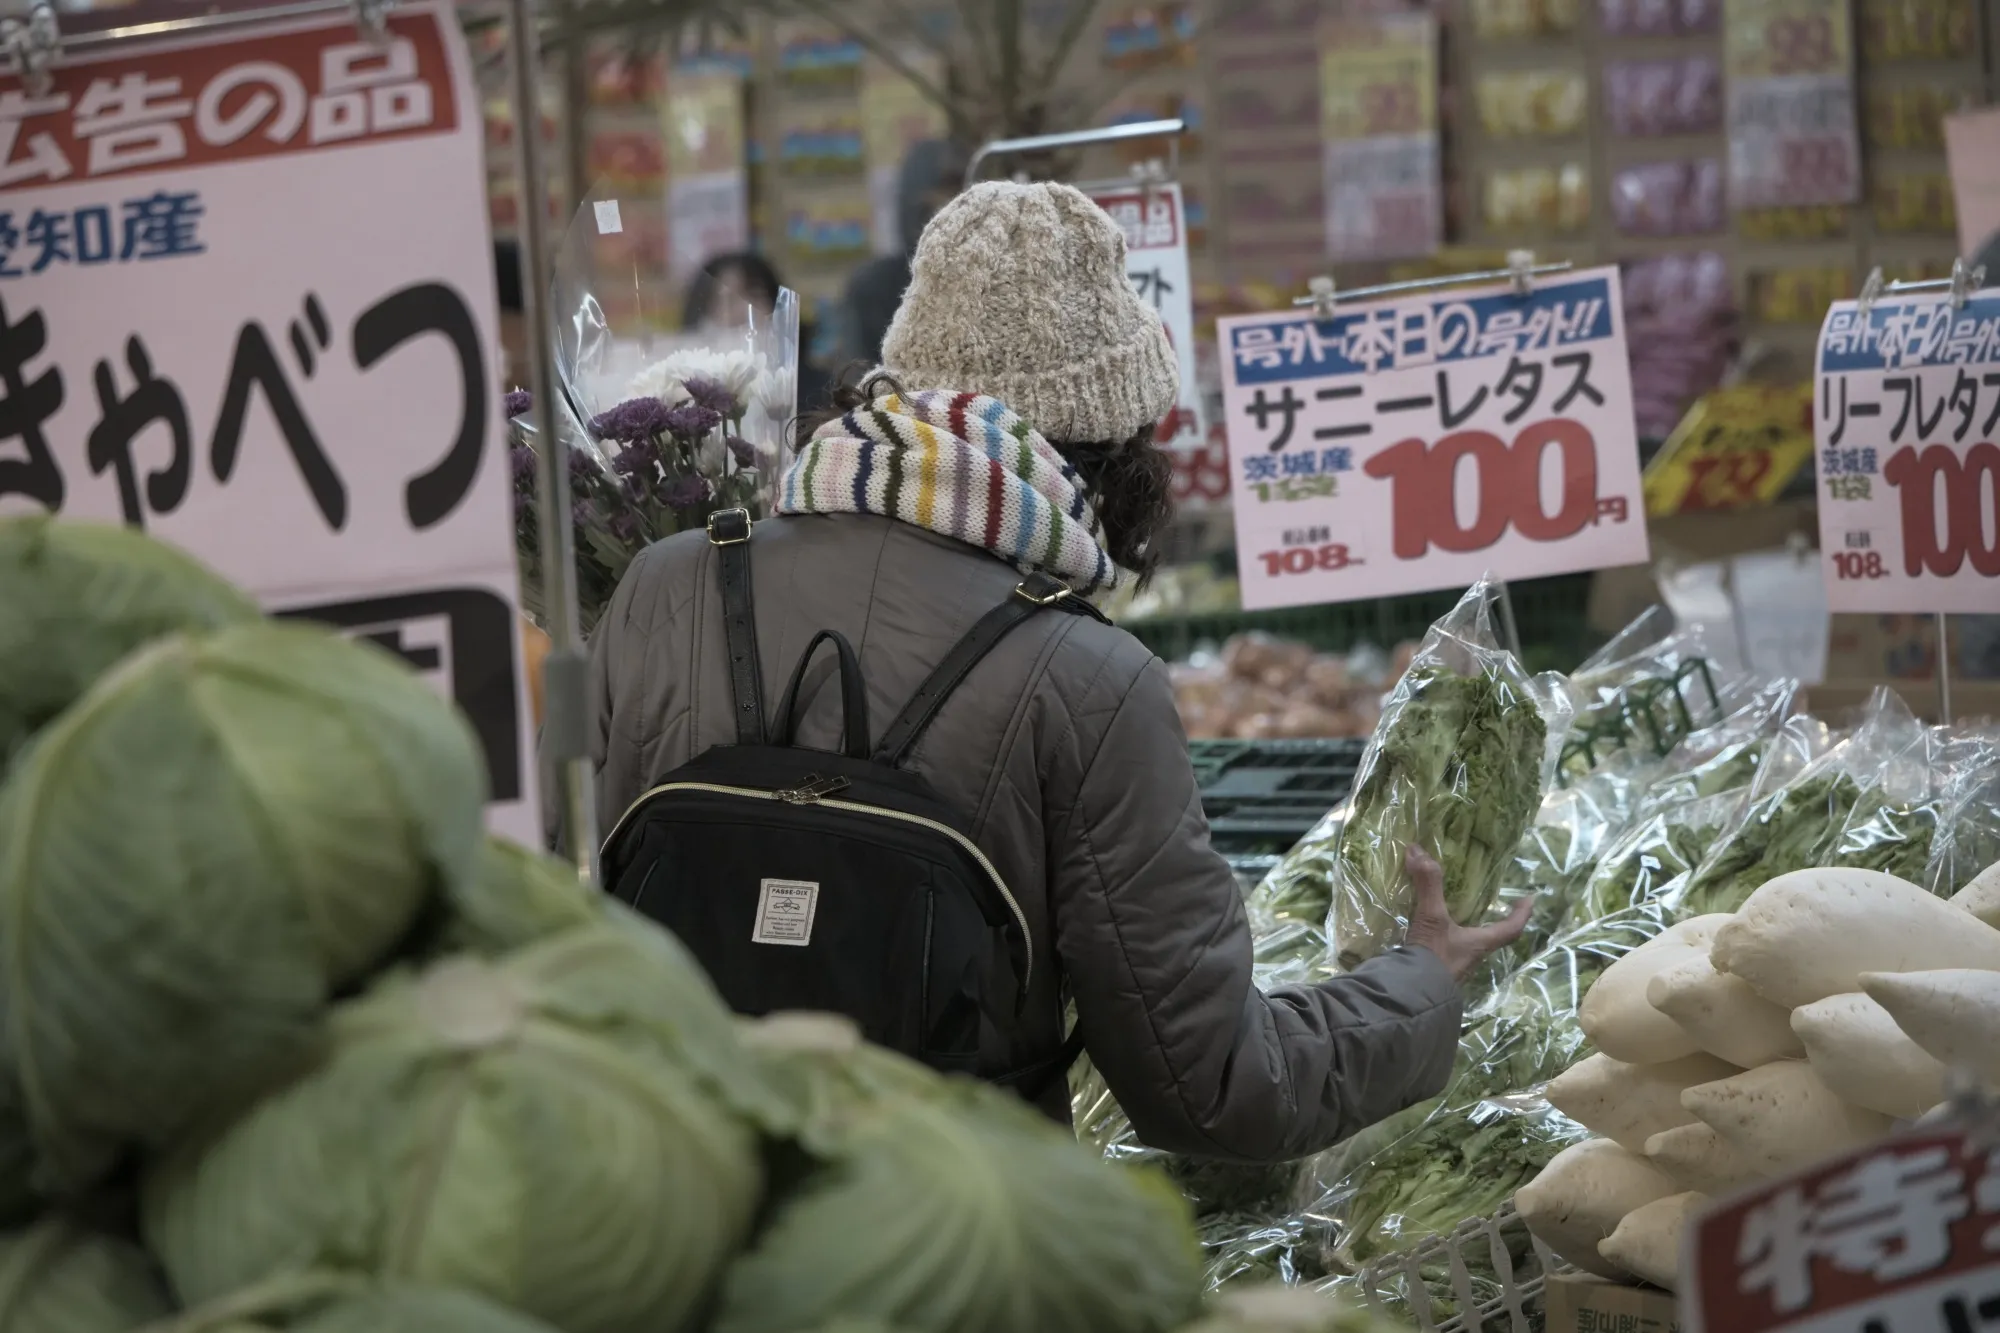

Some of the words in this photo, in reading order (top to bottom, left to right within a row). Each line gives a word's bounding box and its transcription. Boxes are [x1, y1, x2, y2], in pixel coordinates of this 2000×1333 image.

[1245, 351, 1605, 452] サニーレタス
